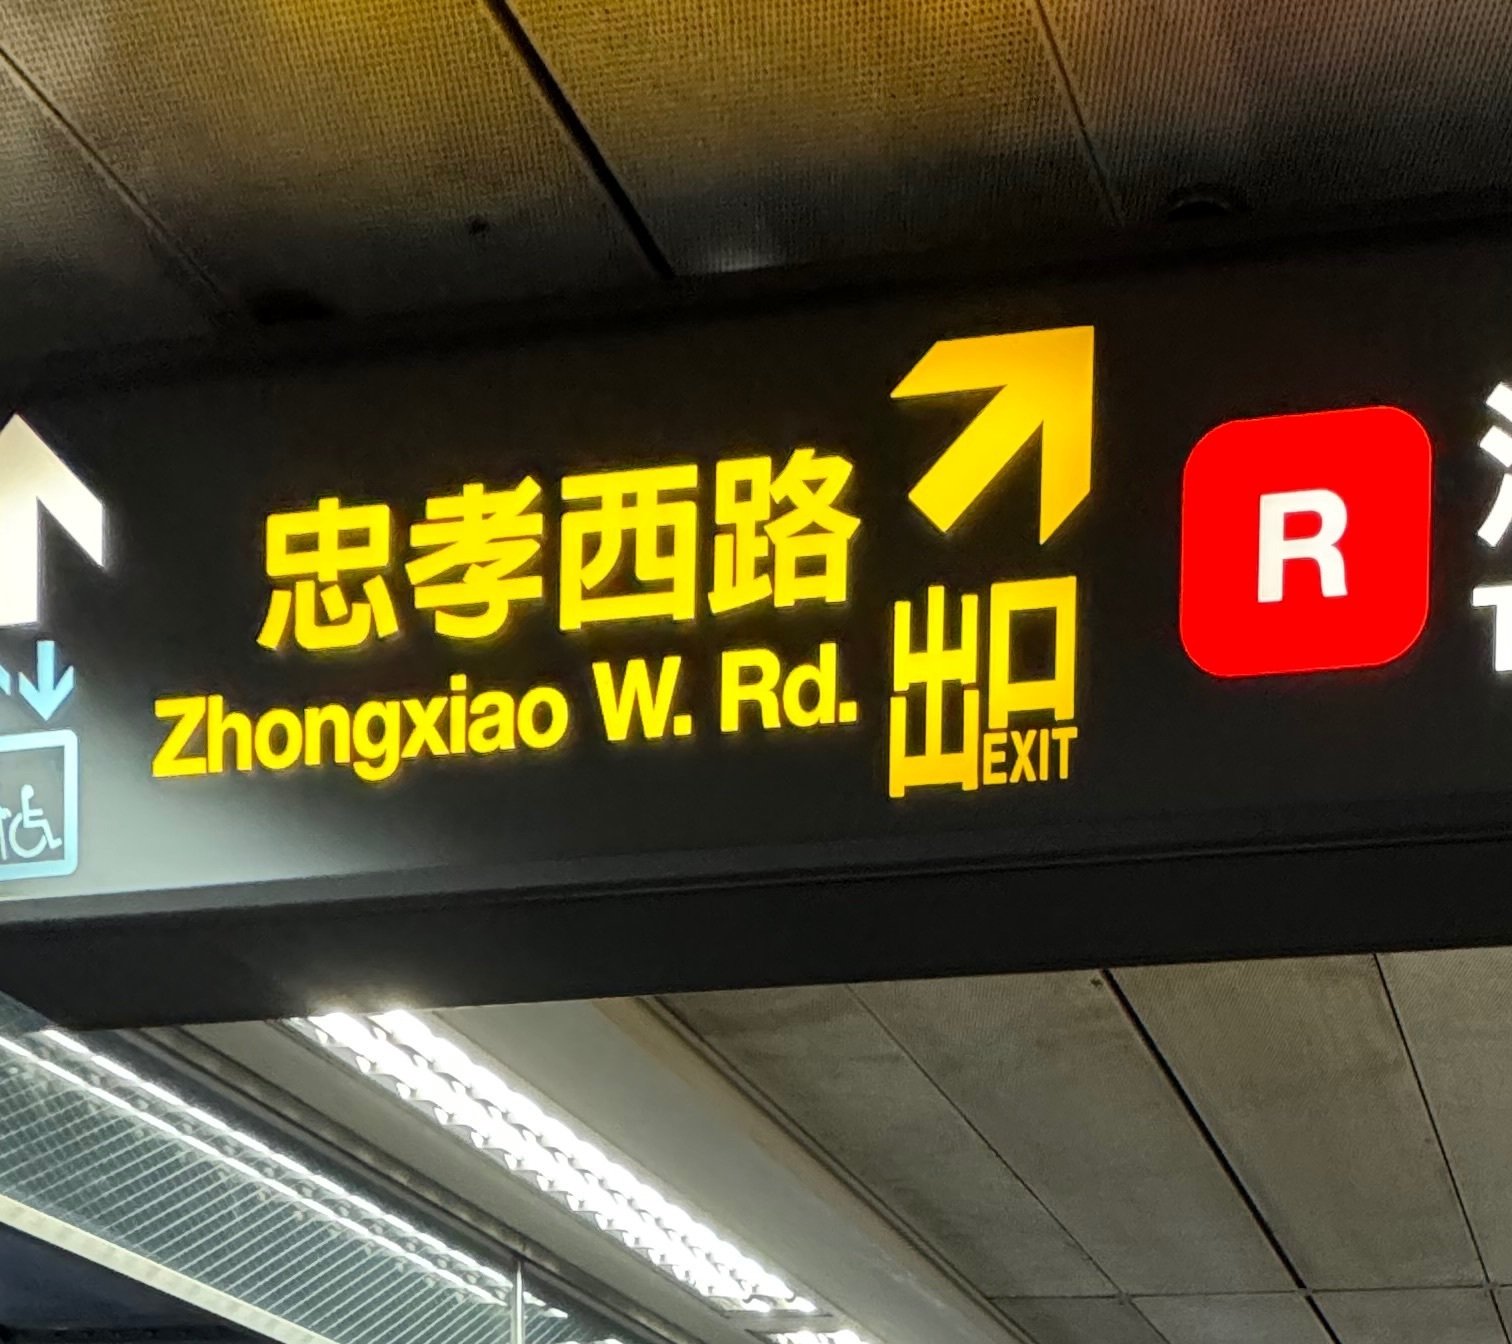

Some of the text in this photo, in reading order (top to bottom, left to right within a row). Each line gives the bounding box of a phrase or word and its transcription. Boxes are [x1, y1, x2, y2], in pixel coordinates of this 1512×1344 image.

[257, 447, 860, 652] 忠孝西路
[1257, 489, 1348, 603] R
[151, 643, 858, 784] Zhongxiao W. Rd.
[888, 575, 1077, 797] 出口
[982, 727, 1077, 785] EXIT
